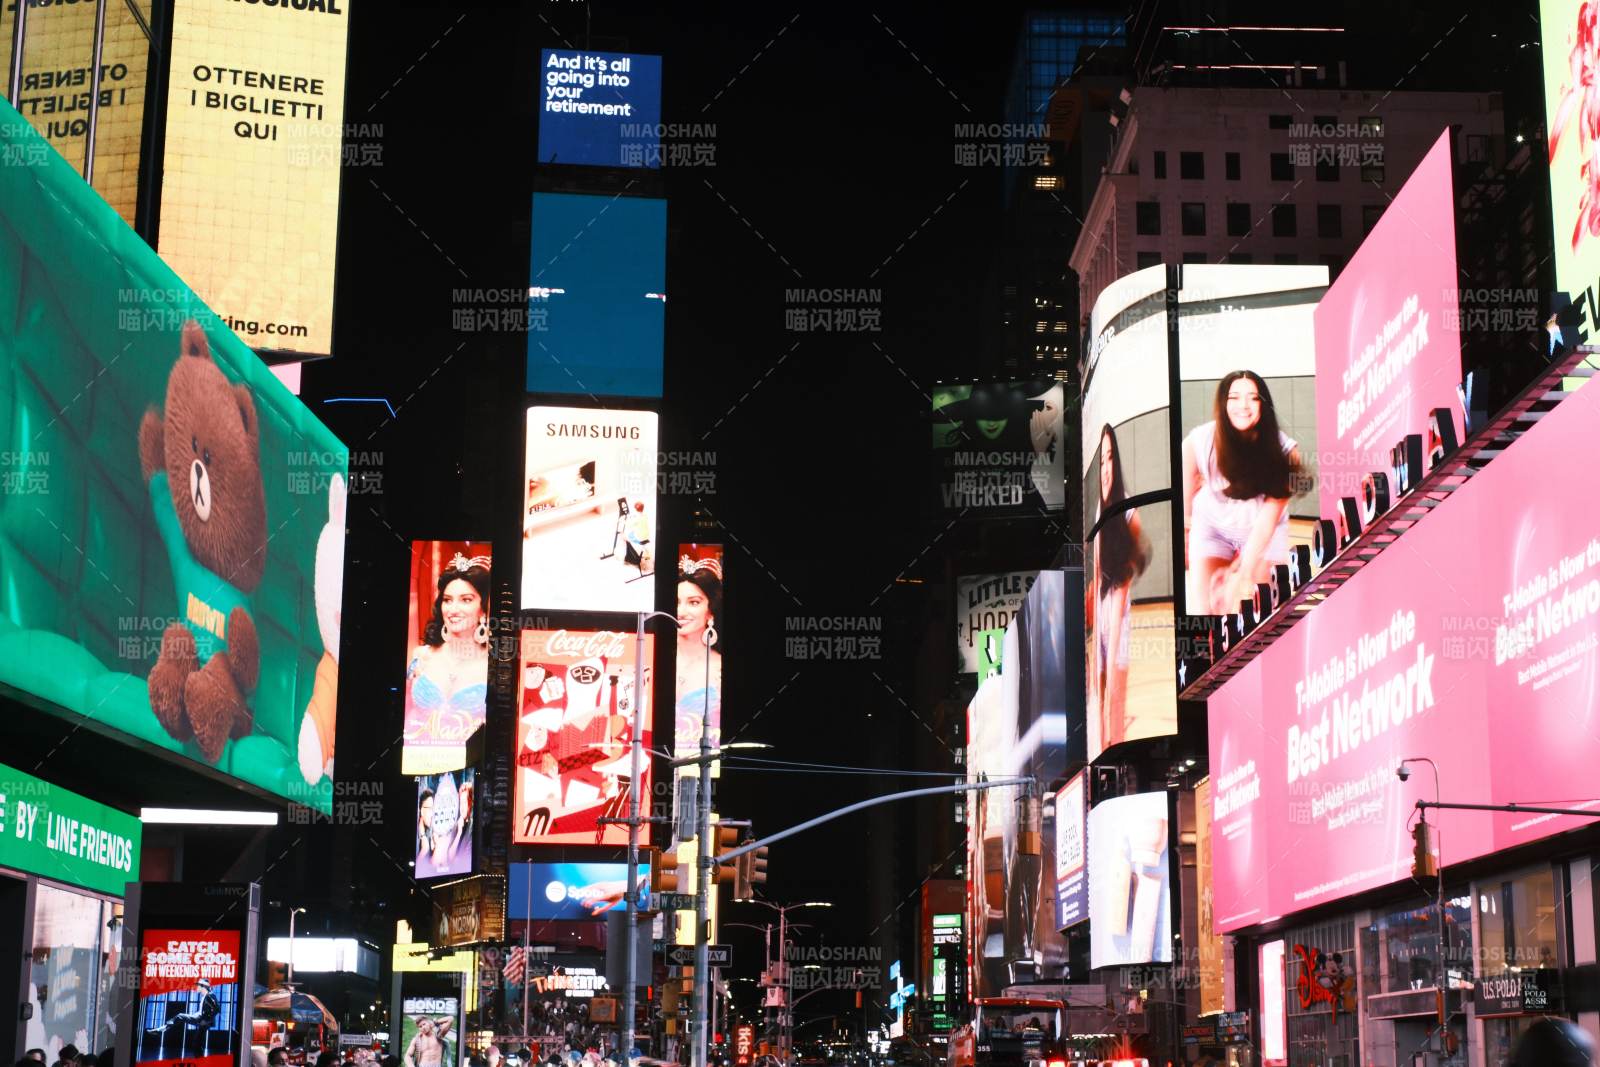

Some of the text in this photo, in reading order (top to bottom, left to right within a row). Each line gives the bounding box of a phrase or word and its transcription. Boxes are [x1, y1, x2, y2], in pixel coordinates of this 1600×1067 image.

[546, 53, 631, 72] And it's all
[193, 65, 324, 96] OTTENERE
[546, 70, 630, 88] going into
[546, 86, 583, 100] your
[191, 90, 323, 121] I BIGLIETTI
[545, 99, 631, 116] retirement
[234, 121, 277, 141] QUI
[1337, 378, 1365, 440] Best
[1366, 309, 1430, 408] Network
[546, 423, 640, 440] SAMSUNG
[1560, 552, 1586, 585] Now
[968, 576, 1020, 609] LITTLE
[546, 629, 626, 658] Coca-Cola
[1496, 608, 1535, 667] Best
[1296, 609, 1416, 715] T-Mobile is Now the
[1287, 642, 1435, 784] Best Network
[404, 709, 486, 741] Aladd
[16, 800, 133, 873] BY LINE FRIENDS
[661, 895, 682, 909] W 45
[167, 940, 219, 954] CATCH
[675, 950, 725, 961] ONE AY
[146, 952, 236, 965] SOME COOL
[145, 964, 235, 978] ON WEEKENDS WITH MJ
[1482, 978, 1517, 1000] U.S. POLO
[1524, 990, 1546, 998] POLO
[404, 999, 455, 1011] BONDS
